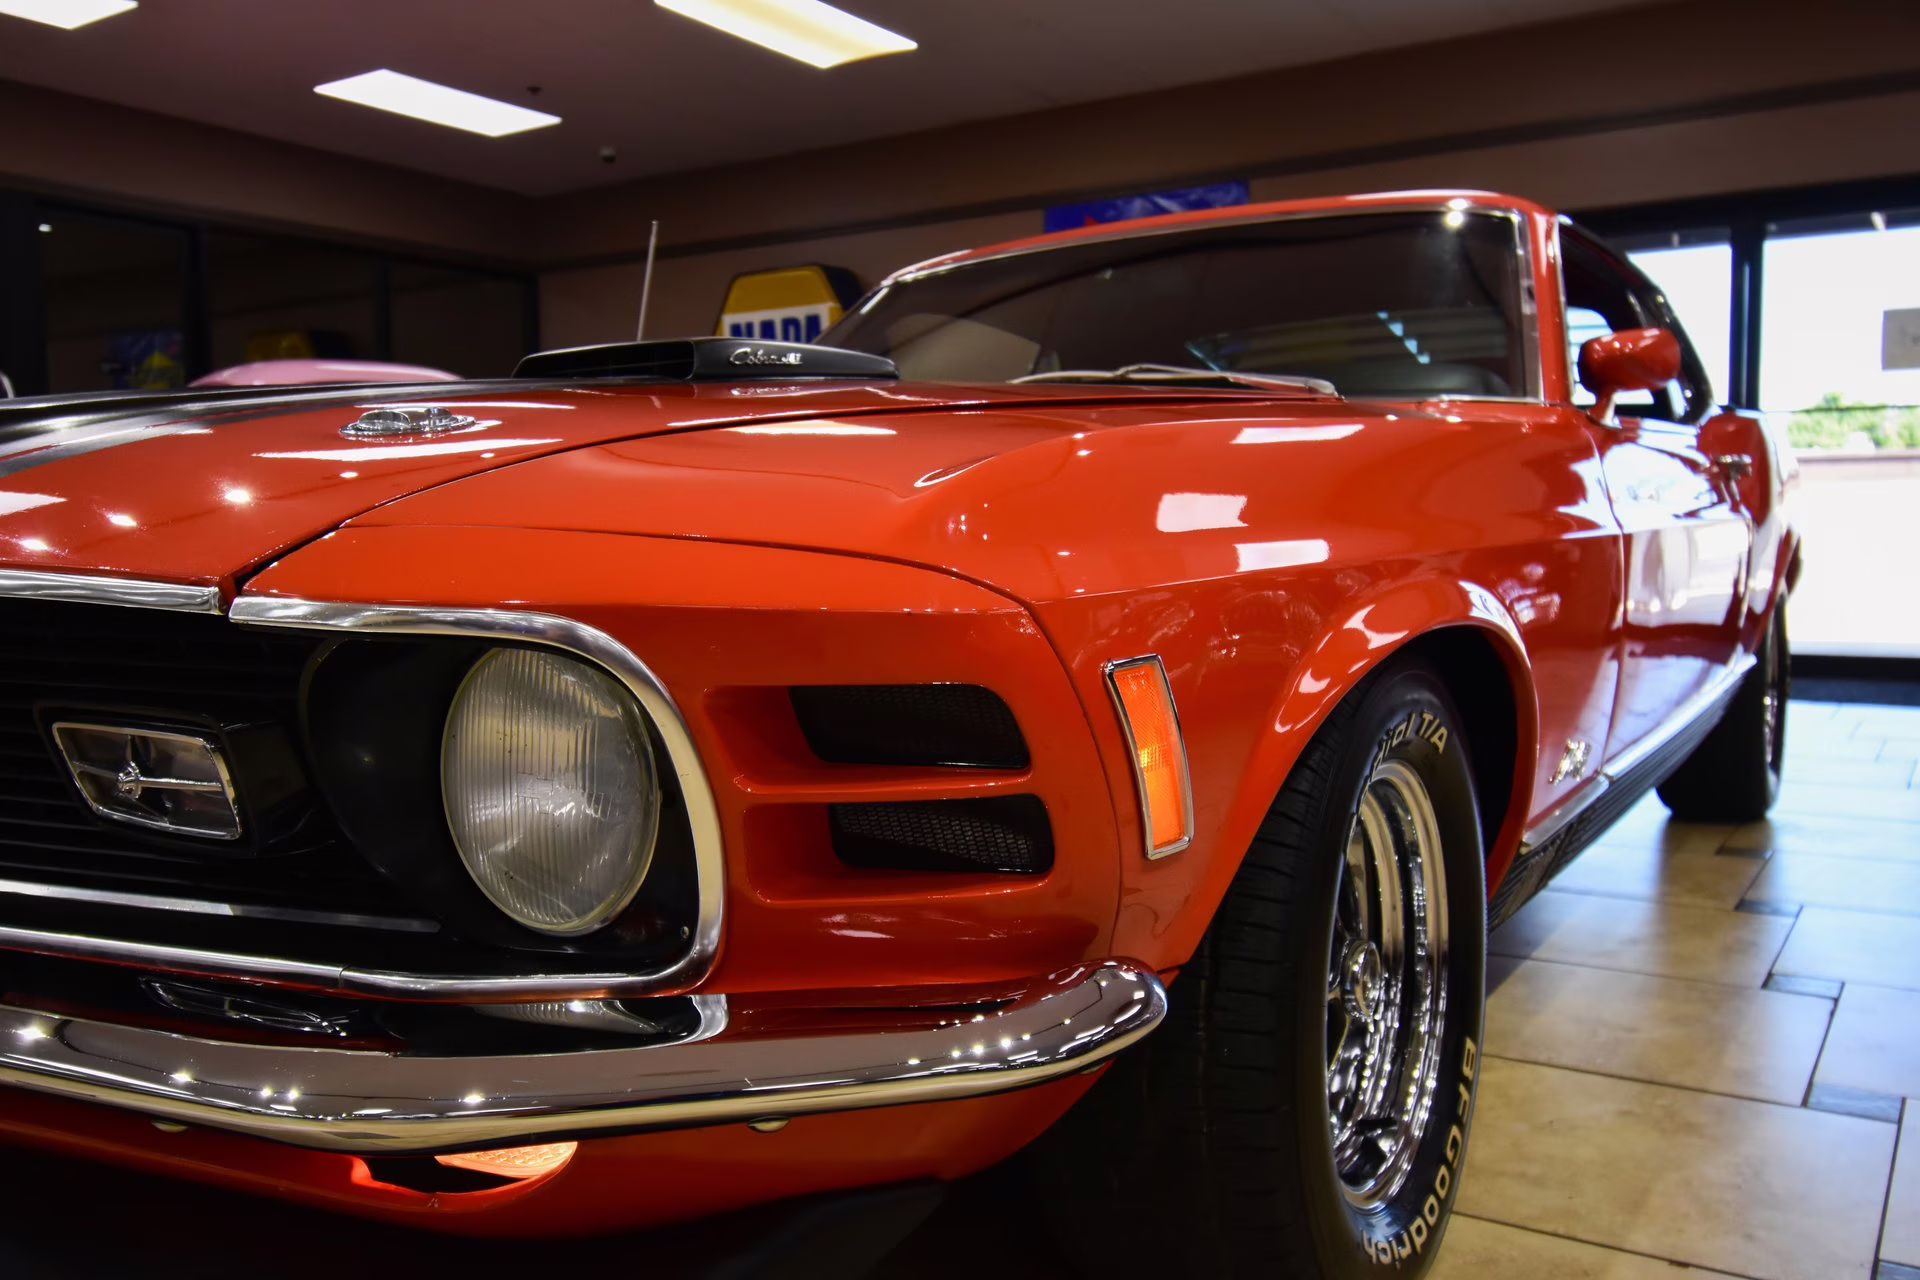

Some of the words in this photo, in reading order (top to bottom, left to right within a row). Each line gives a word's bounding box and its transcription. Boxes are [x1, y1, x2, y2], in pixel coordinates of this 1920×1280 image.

[730, 346, 780, 364] Cobra
[1422, 711, 1448, 754] T/A
[1362, 1037, 1476, 1269] BFGoodrich
